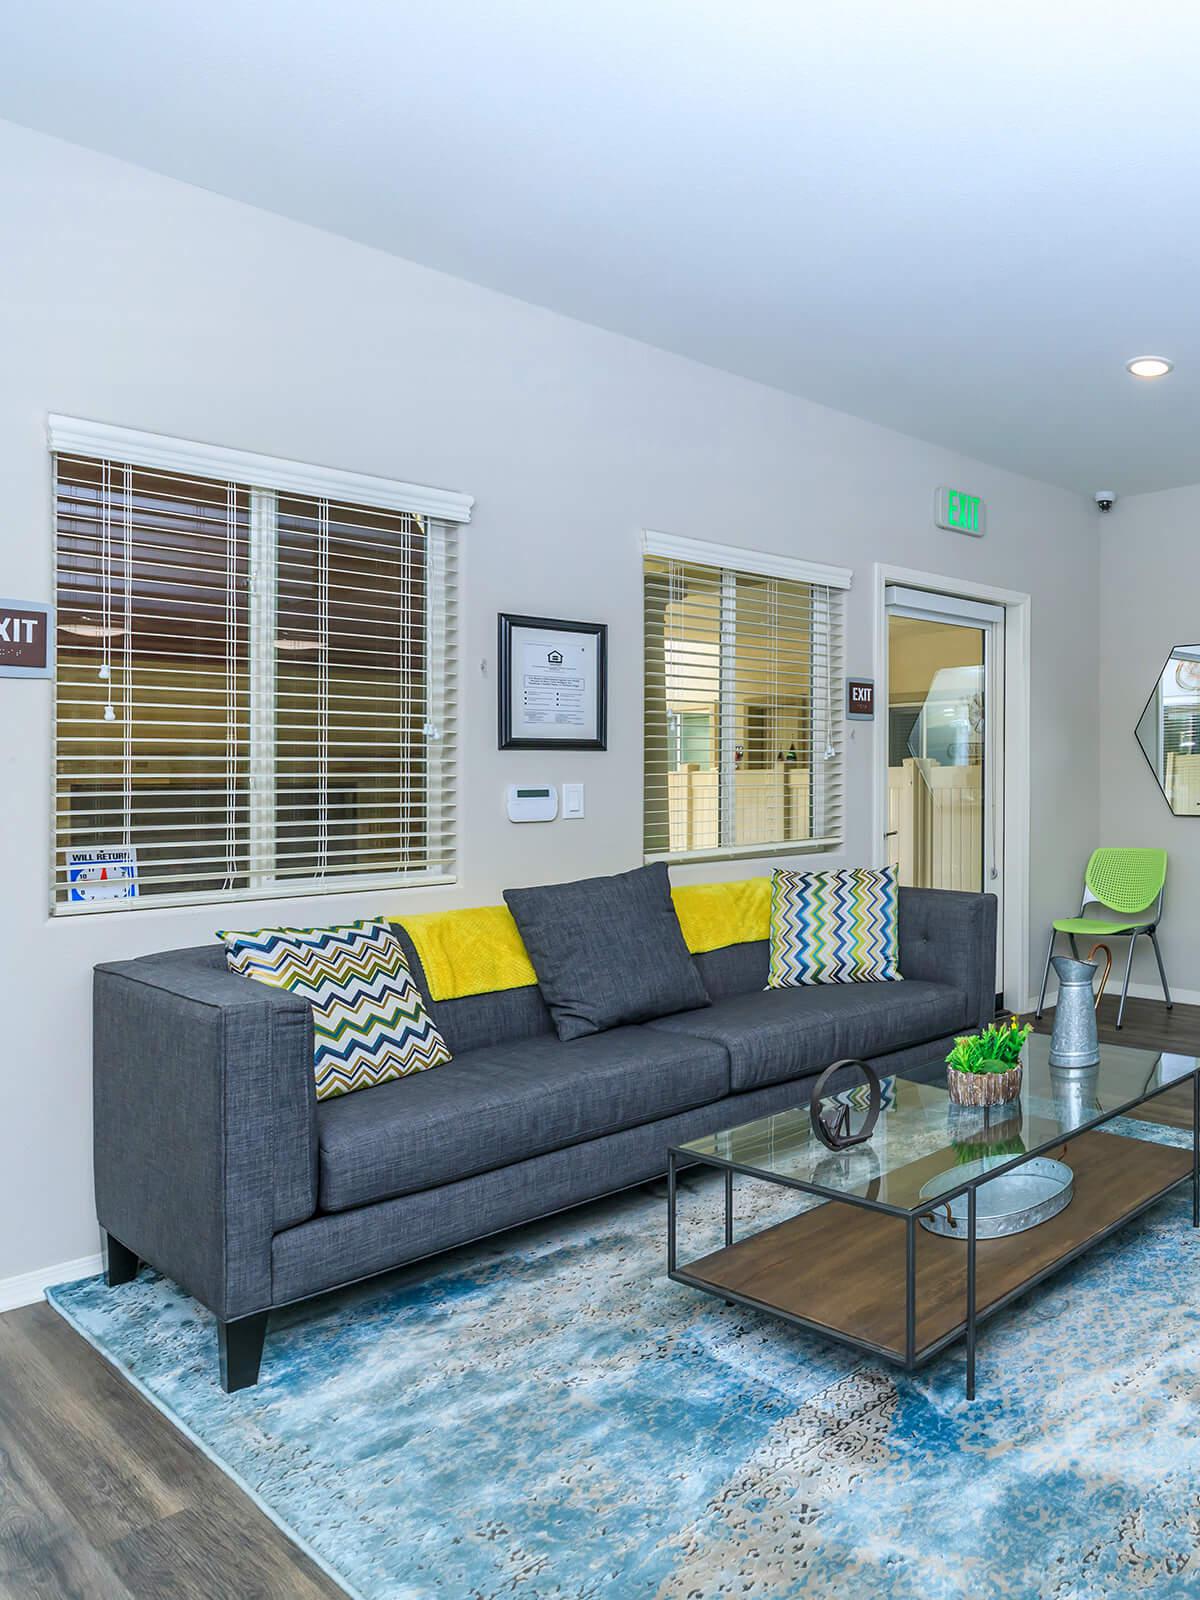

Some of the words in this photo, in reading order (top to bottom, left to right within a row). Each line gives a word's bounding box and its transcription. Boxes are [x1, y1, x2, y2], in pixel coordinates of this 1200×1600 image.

[948, 489, 981, 531] EXIT
[0, 617, 39, 644] XIT
[852, 687, 872, 702] EXIT
[72, 853, 93, 861] WILL
